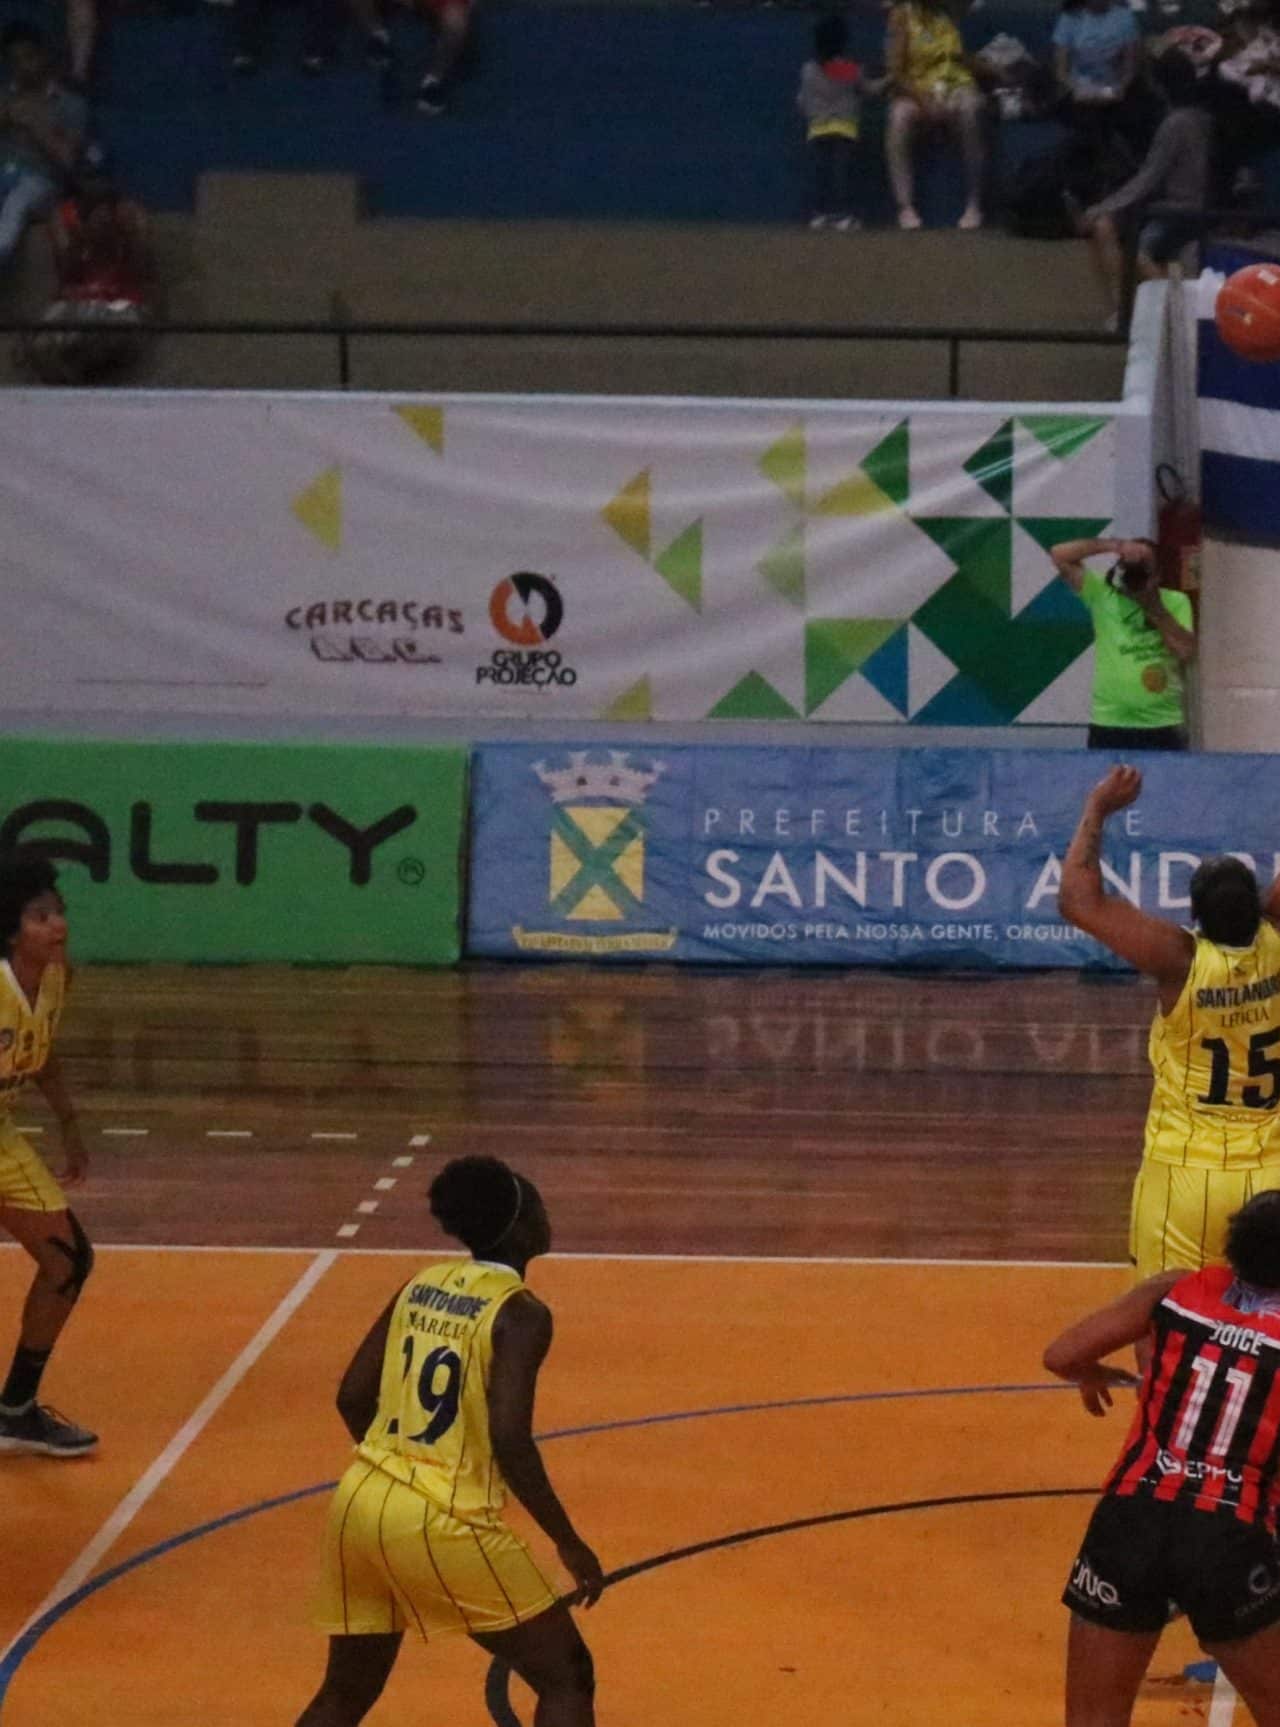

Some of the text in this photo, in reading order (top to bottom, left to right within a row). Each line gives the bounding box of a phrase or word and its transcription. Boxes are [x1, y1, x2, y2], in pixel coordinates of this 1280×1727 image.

[492, 649, 561, 668] GRUPO
[704, 809, 1039, 836] PREFEITURA
[704, 848, 986, 910] SANTO
[703, 923, 796, 940] MOVIDOS
[804, 923, 849, 940] PELA
[856, 923, 925, 941] NOSSA
[1209, 1319, 1267, 1357] JOICE
[386, 1334, 462, 1447] 19
[1175, 1354, 1253, 1458] 11
